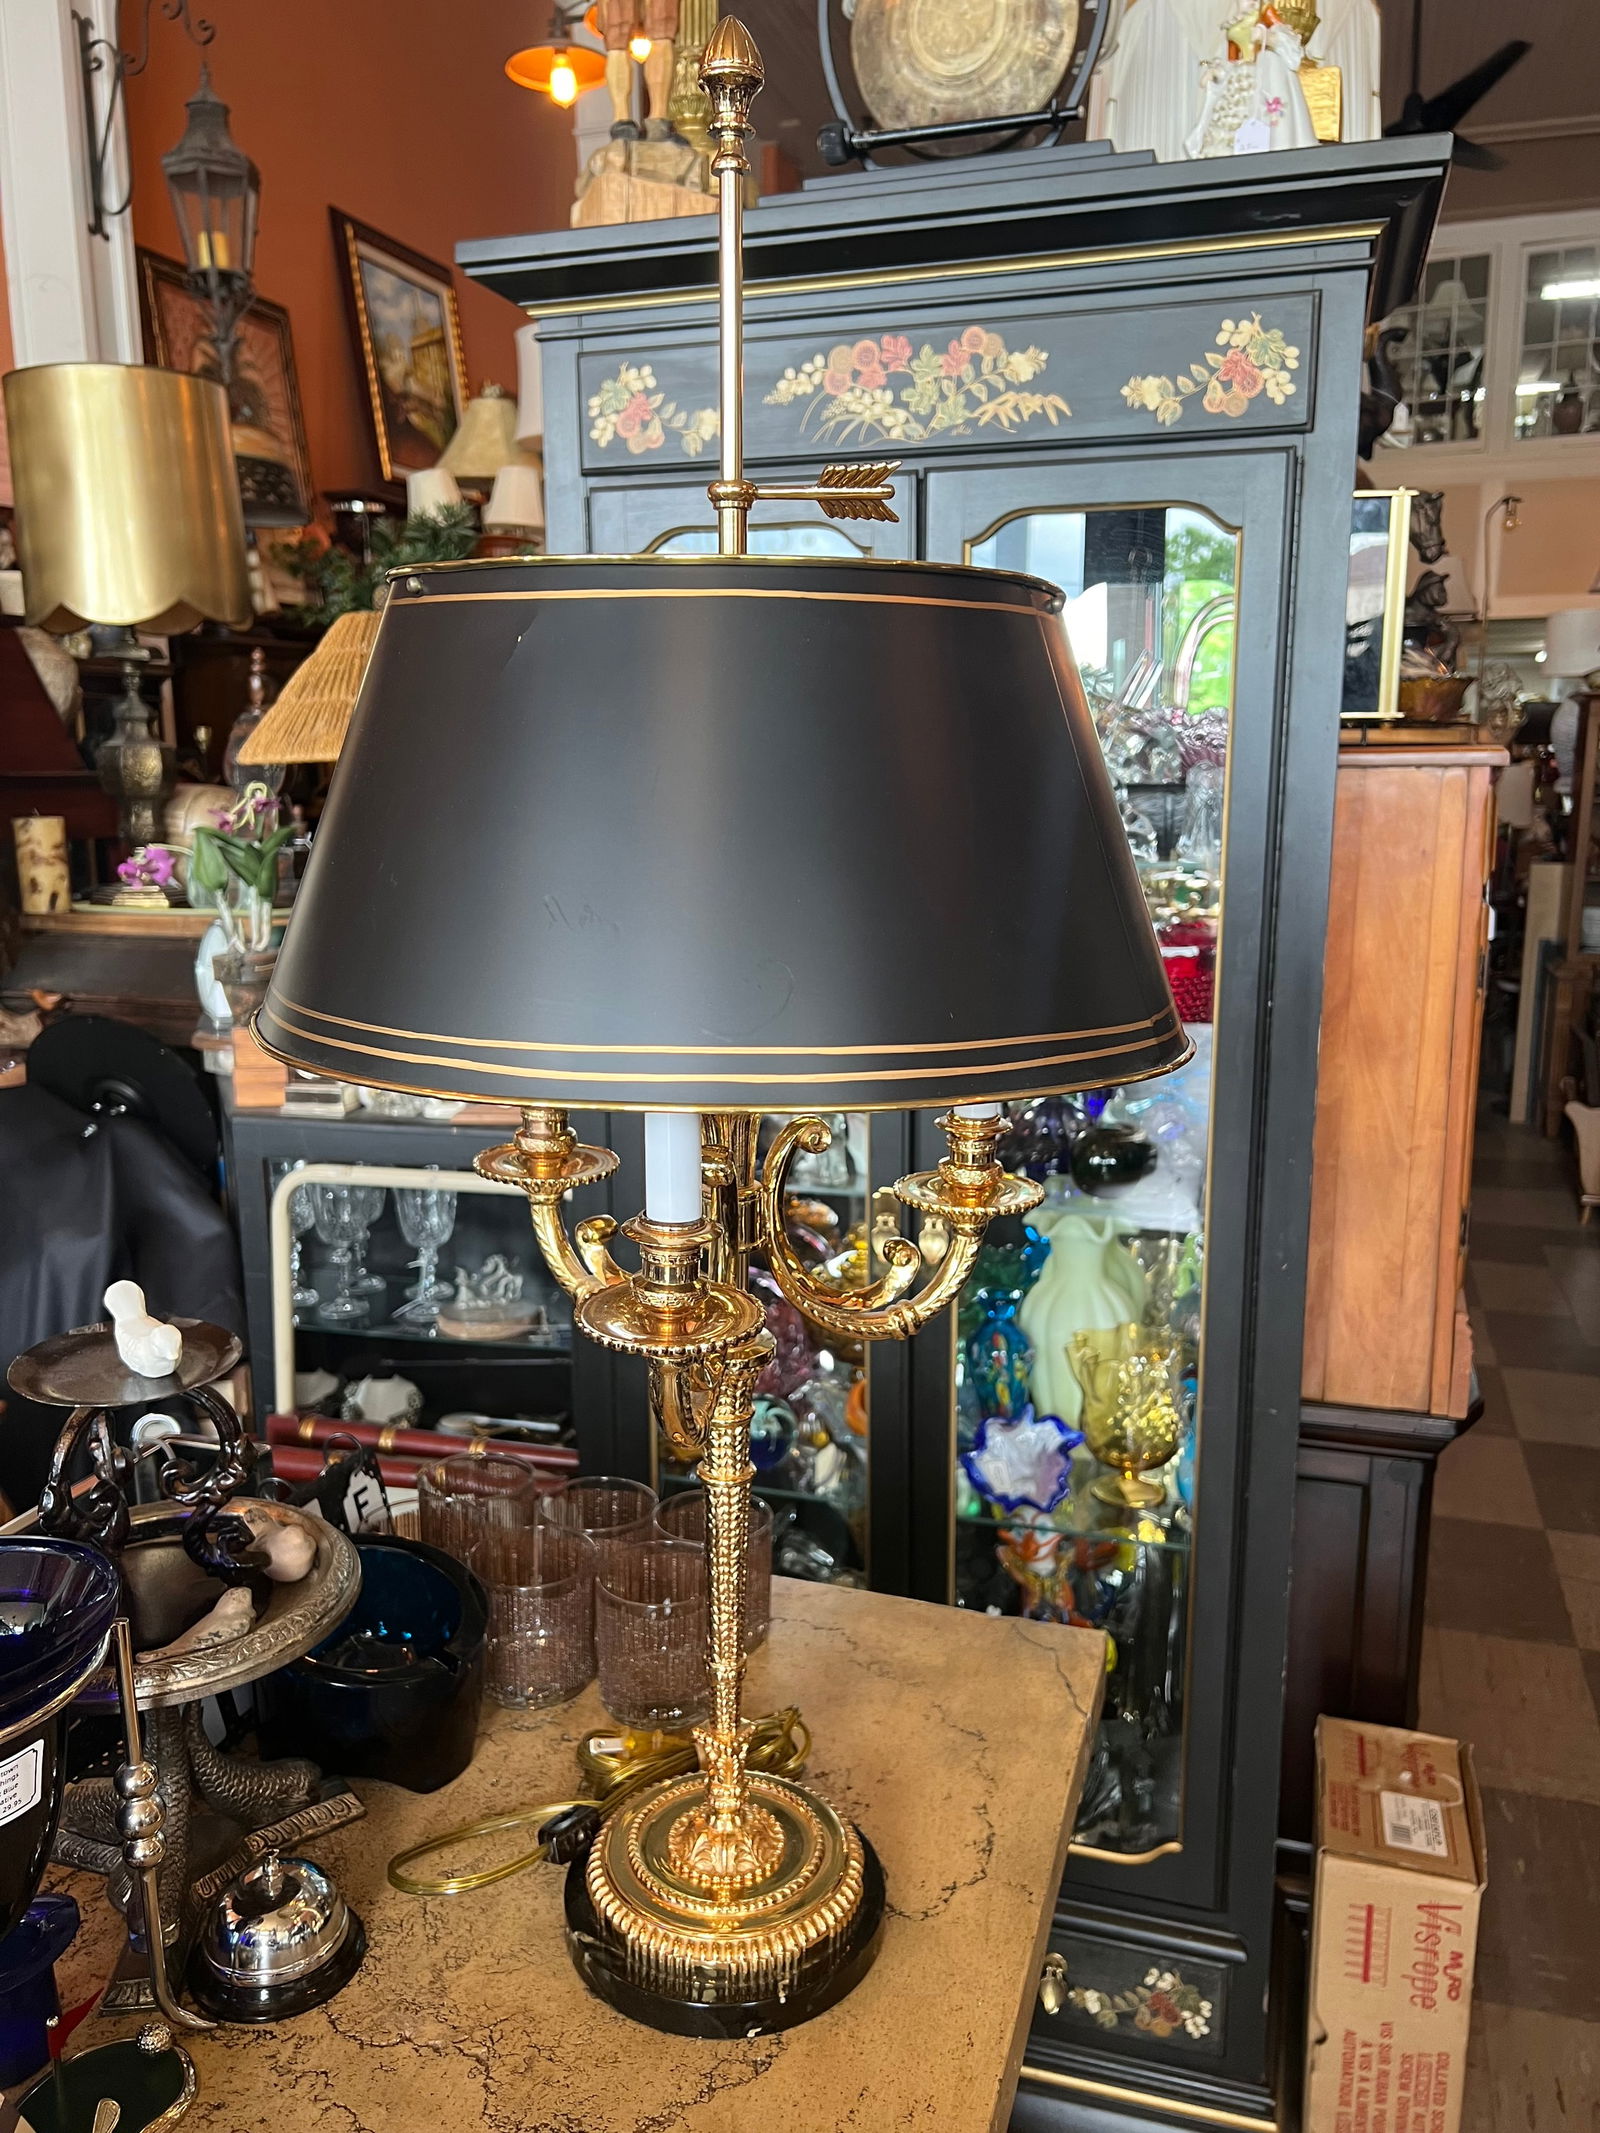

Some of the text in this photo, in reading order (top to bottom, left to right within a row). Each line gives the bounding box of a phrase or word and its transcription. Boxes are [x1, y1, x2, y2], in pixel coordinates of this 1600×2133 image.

[3, 1783, 19, 1796] Blue
[2, 1798, 22, 1813] 29.95
[1401, 1901, 1463, 2009] Visrope
[1443, 1951, 1463, 2001] MURO
[1380, 2022, 1393, 2039] VIS
